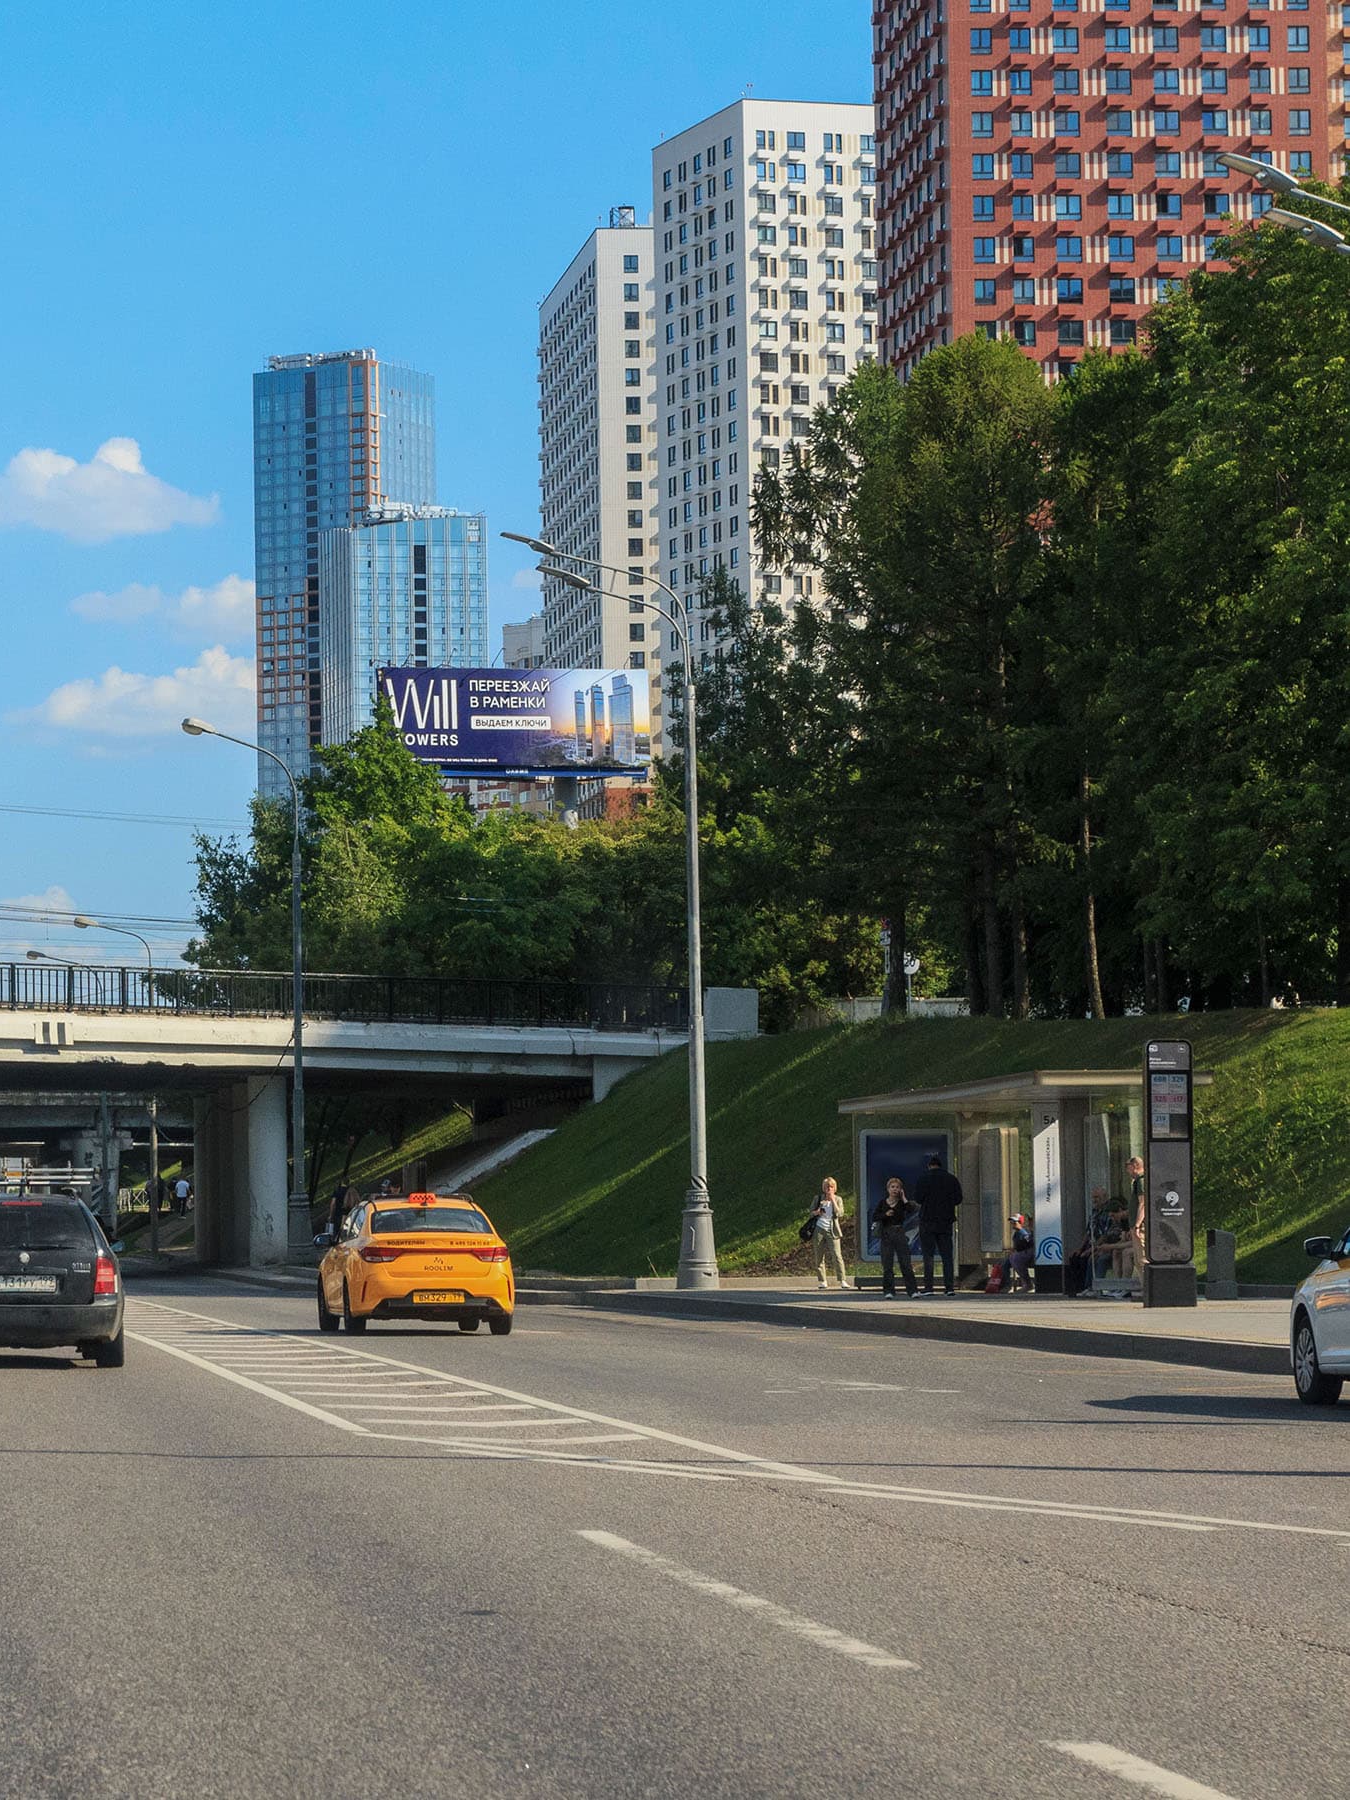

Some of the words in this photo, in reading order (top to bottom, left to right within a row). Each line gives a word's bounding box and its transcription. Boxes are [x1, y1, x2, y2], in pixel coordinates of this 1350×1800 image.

[469, 677, 550, 693] ПЕРЕЕЗЖАЙ
[386, 678, 459, 730] Will
[469, 696, 479, 709] В
[482, 696, 546, 709] РАМЕНКИ
[475, 718, 513, 728] ВЫДАЕМ
[515, 718, 547, 728] КЛЮЧИ
[399, 733, 459, 746] OWERS
